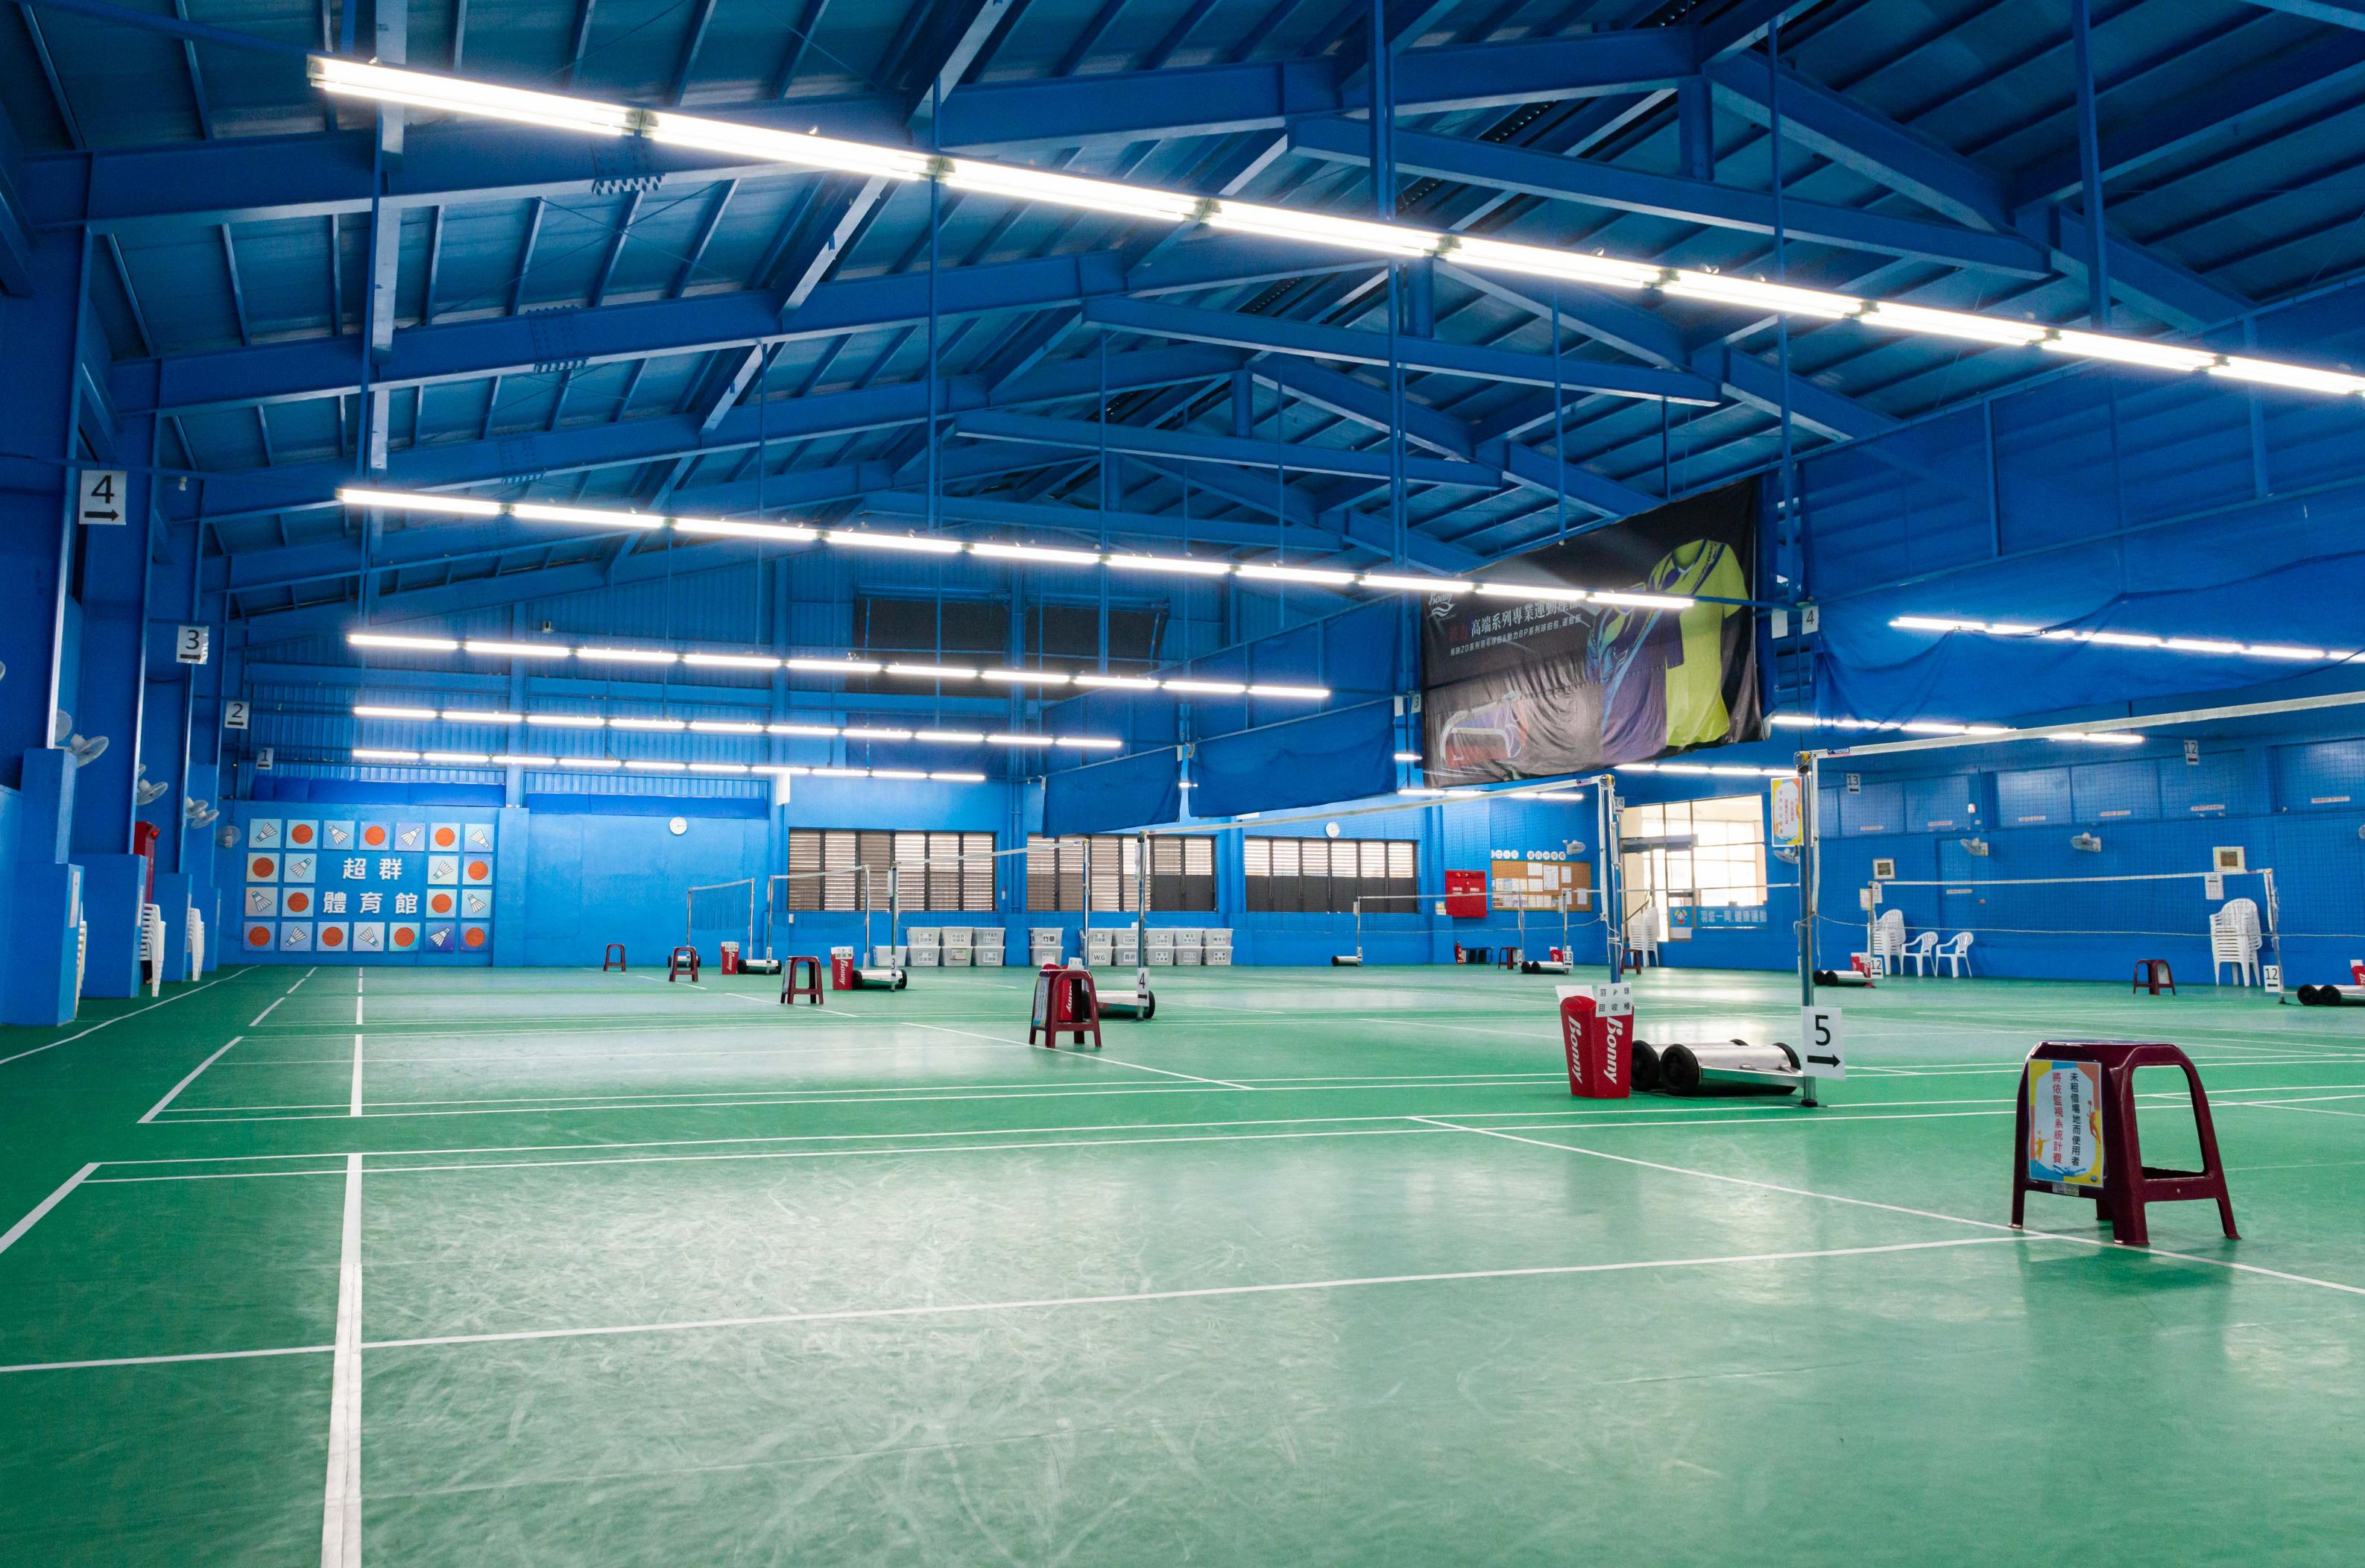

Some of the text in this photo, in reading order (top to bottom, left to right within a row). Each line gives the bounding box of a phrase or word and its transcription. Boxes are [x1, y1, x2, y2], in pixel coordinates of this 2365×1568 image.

[91, 475, 115, 504] 4
[1806, 610, 1814, 625] 4
[185, 630, 200, 650] 3
[1414, 697, 1419, 708] 3
[231, 703, 242, 718] 2
[2185, 742, 2197, 754] 12
[262, 750, 269, 762] 1
[1848, 775, 1859, 785] 13
[1614, 798, 1624, 806] 14
[342, 858, 402, 880] 超群
[323, 891, 418, 914] 體育館
[1564, 953, 1573, 961] 13
[839, 959, 849, 985] Bonny
[1872, 960, 1882, 970] 12
[1139, 973, 1146, 989] 4
[2265, 968, 2278, 980] 12
[1815, 1014, 1831, 1046] 5
[1568, 1015, 1582, 1084] Bonny
[1604, 1017, 1623, 1084] Bonny
